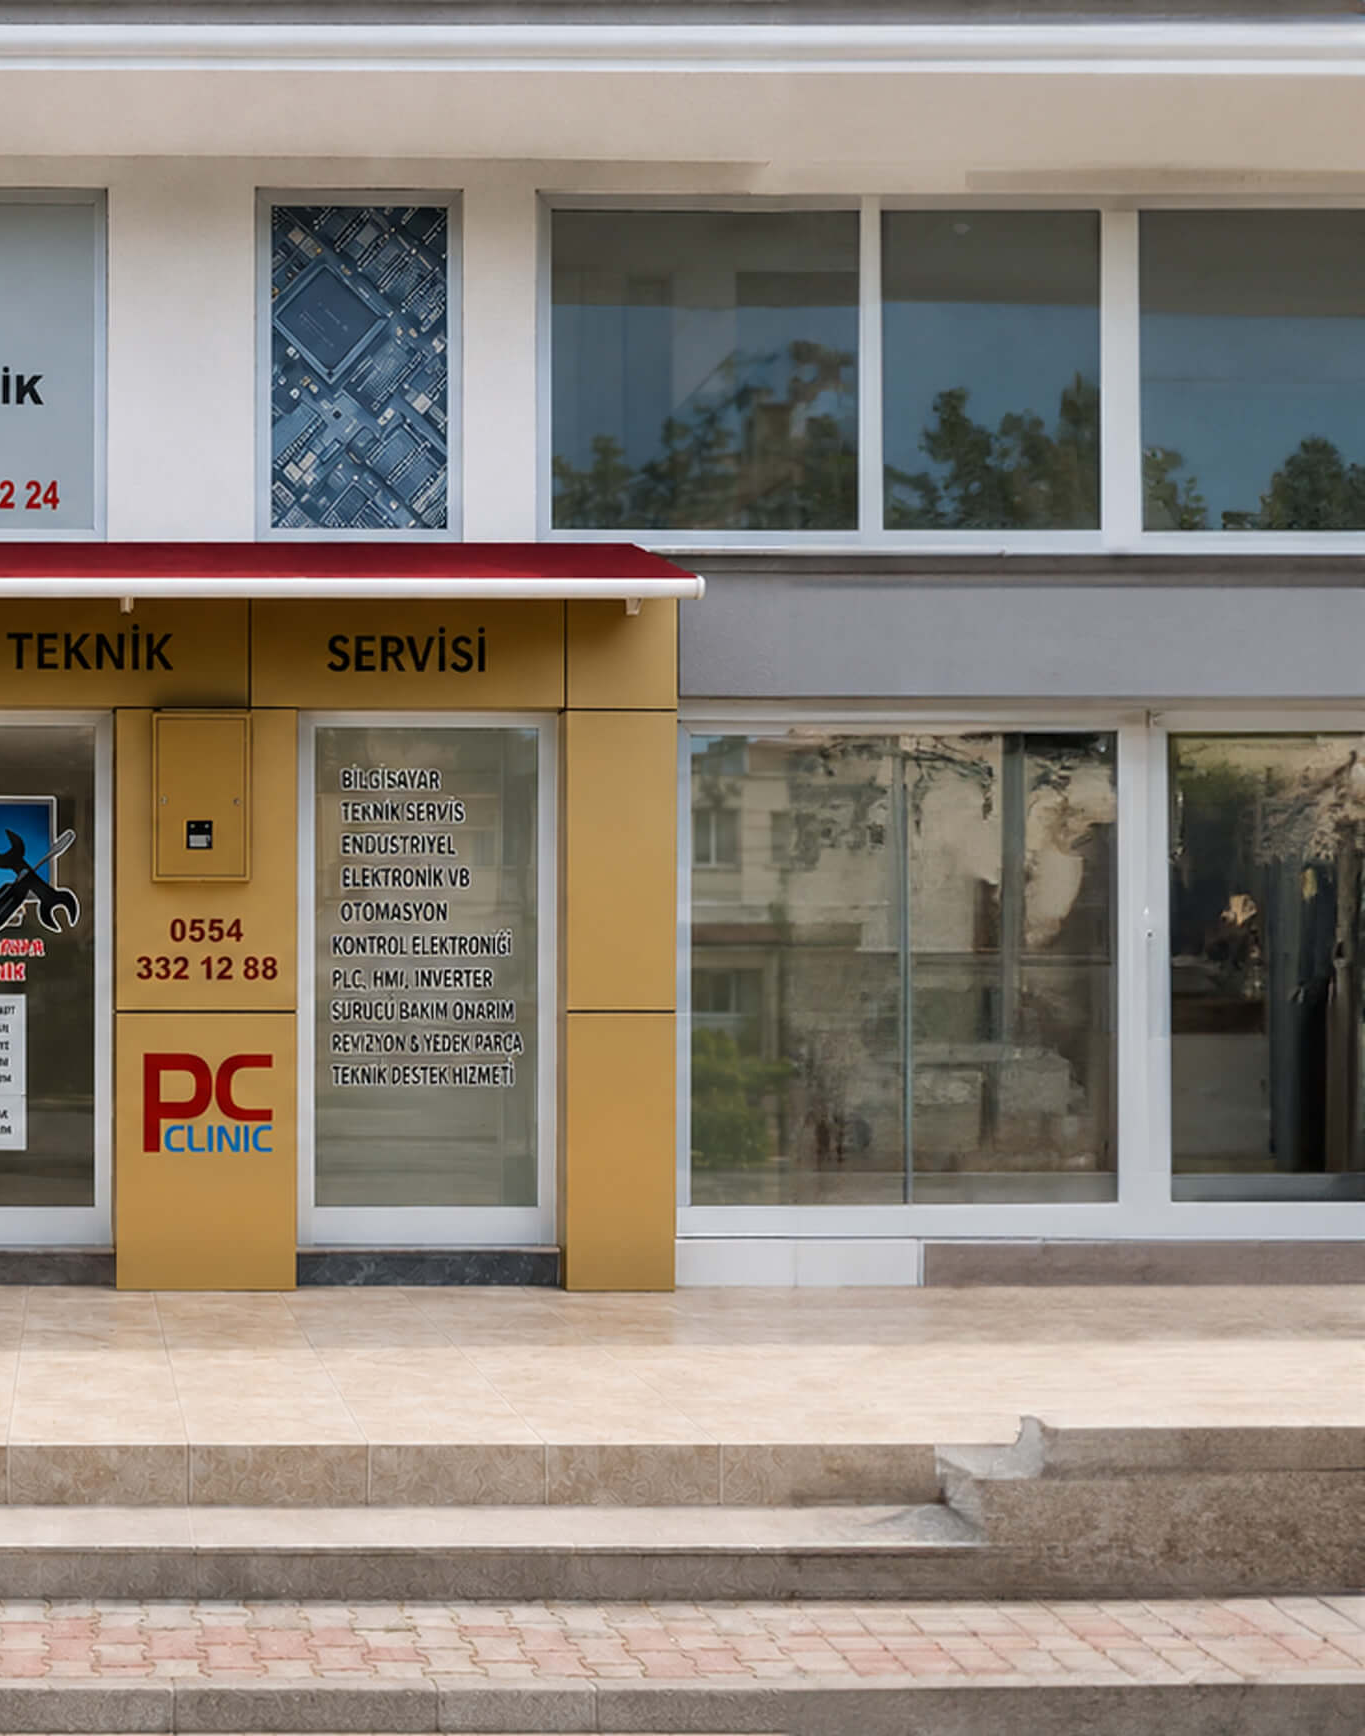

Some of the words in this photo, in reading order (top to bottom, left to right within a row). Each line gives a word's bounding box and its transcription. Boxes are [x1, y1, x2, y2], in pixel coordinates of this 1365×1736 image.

[25, 480, 60, 510] 24
[7, 624, 173, 671] TEKNİK
[326, 626, 486, 673] SERVİSİ
[341, 902, 448, 922] OTOMASYON
[170, 918, 243, 942] 0554
[332, 935, 408, 956] KONTROL
[136, 957, 190, 980] 332
[201, 957, 234, 980] 12
[243, 957, 278, 980] 88
[399, 1001, 448, 1020] BAKIM
[453, 1001, 515, 1020] ONARIM
[423, 1033, 470, 1052] YEDEK
[391, 1066, 449, 1085] DESTEK
[143, 1053, 273, 1153] PC
[164, 1124, 273, 1153] CLINIC
